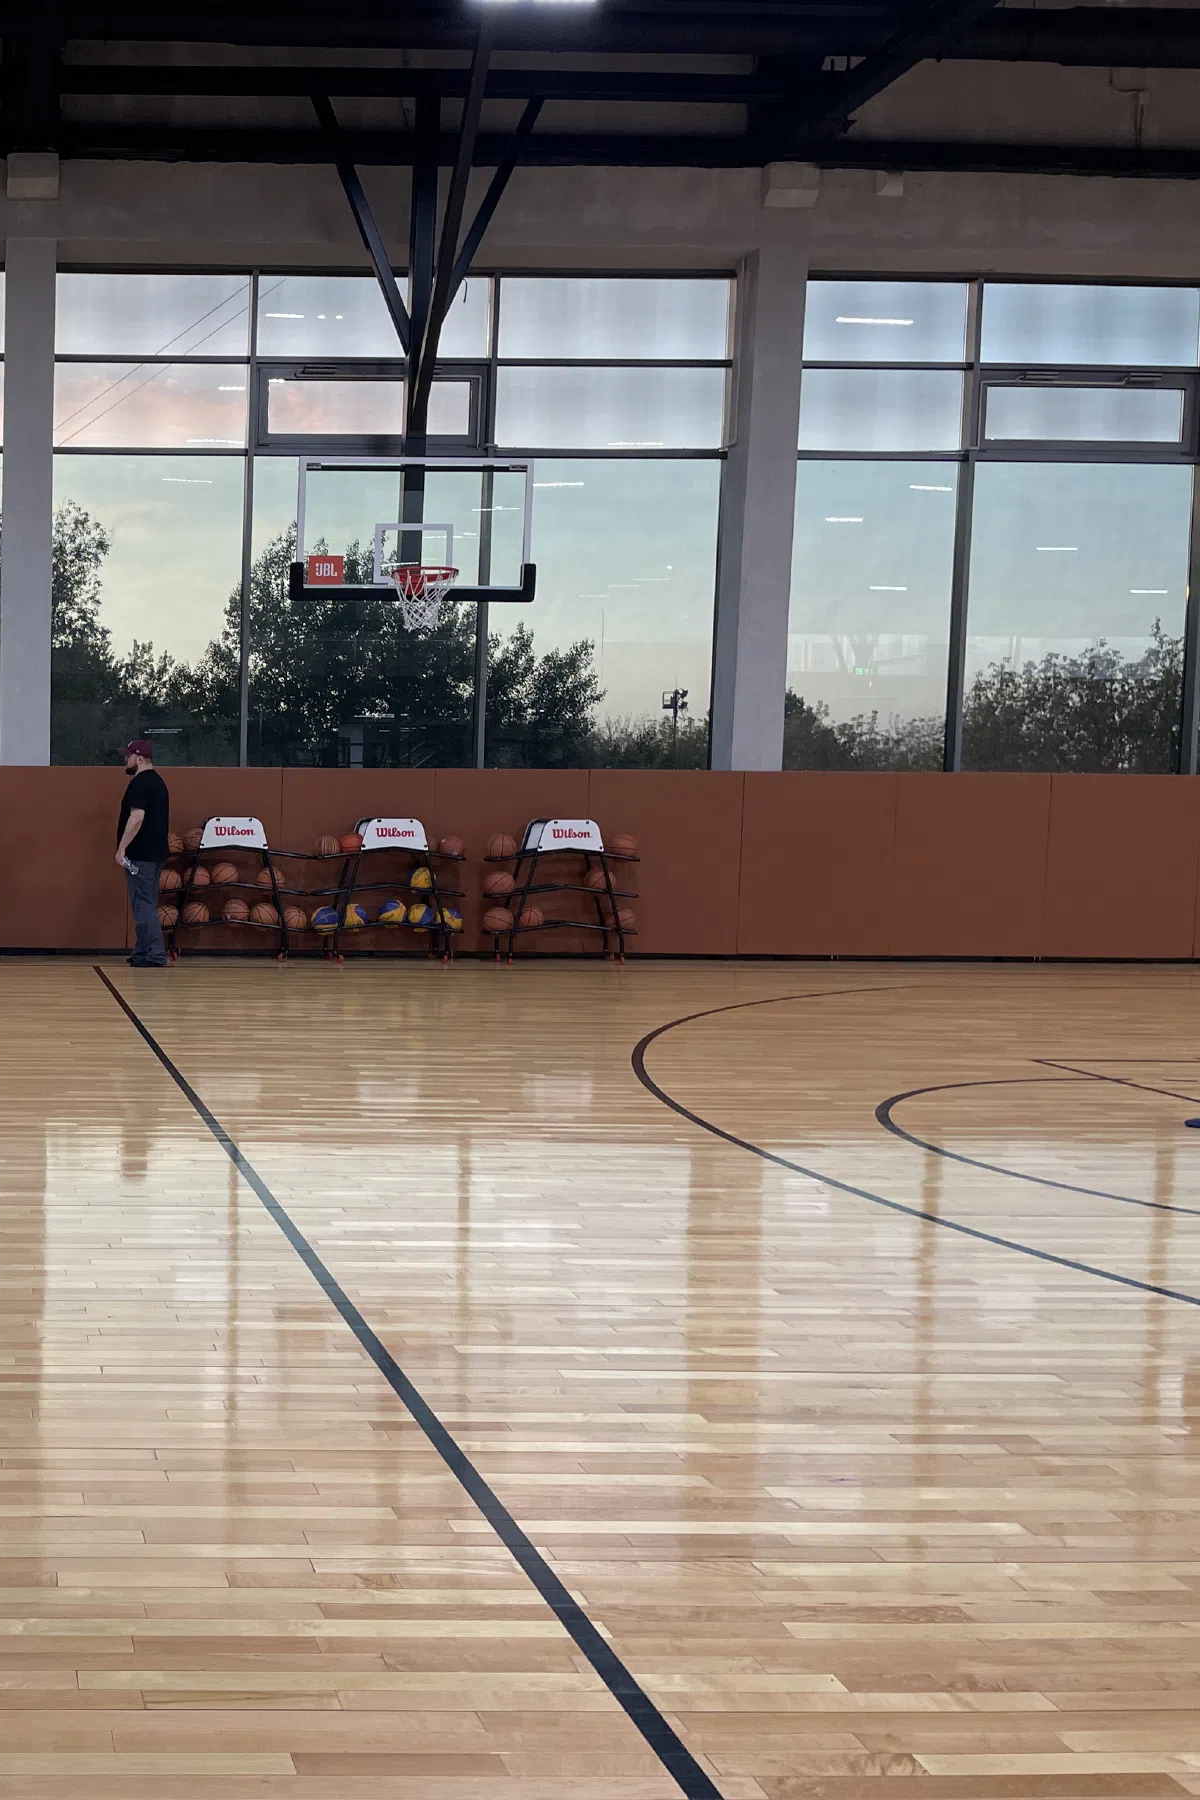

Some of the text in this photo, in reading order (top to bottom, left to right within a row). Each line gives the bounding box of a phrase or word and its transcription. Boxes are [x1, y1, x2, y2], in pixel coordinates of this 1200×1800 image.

[315, 563, 338, 577] JBL
[214, 826, 254, 836] Wilson
[375, 827, 415, 837] Wilson
[552, 828, 591, 838] Wilson
